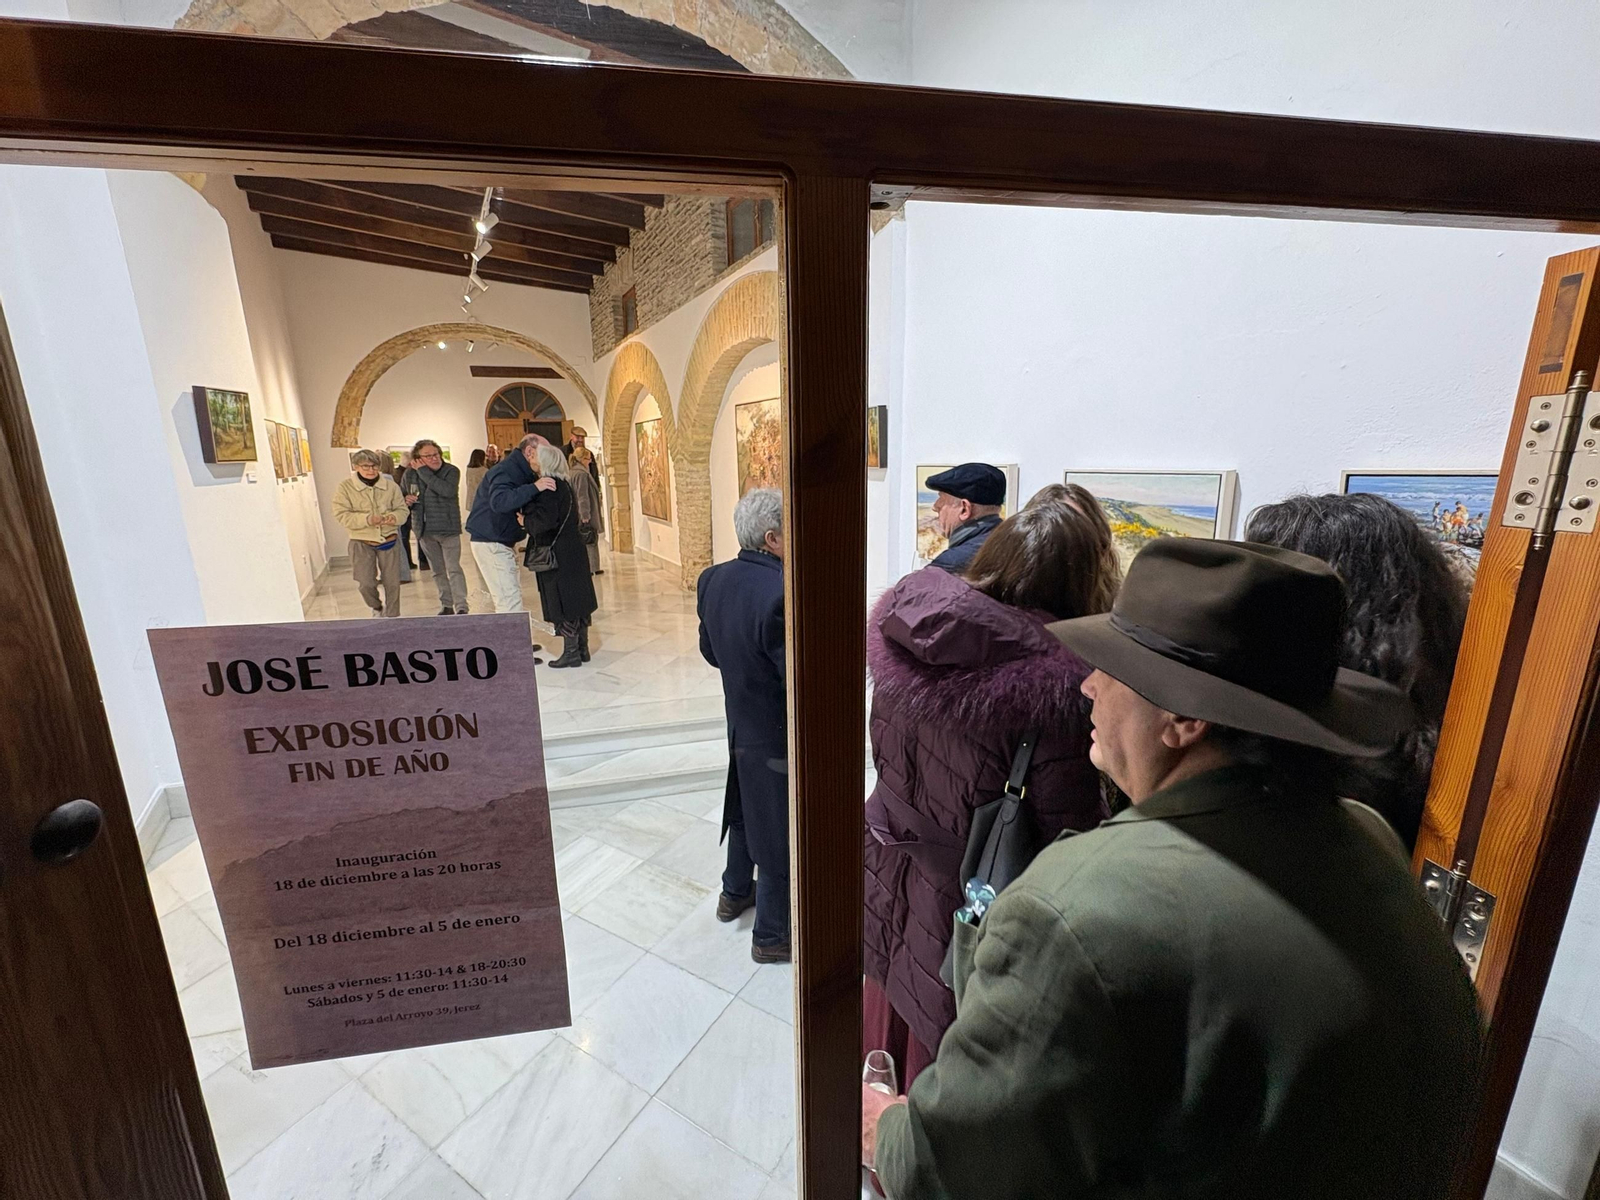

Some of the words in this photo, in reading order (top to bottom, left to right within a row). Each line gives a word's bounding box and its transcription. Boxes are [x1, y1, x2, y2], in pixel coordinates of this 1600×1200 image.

[202, 647, 329, 697] JOSÉ
[344, 646, 499, 687] BASTO
[243, 708, 480, 755] EXPOSICIÓN
[288, 759, 335, 783] FIN
[344, 757, 385, 778] DE
[394, 749, 450, 775] AÑO
[273, 879, 294, 892] 18
[297, 876, 316, 890] de
[320, 868, 398, 887] diciembre
[401, 869, 411, 879] a
[413, 865, 435, 878] las
[437, 863, 457, 876] 20
[459, 859, 501, 873] horas
[335, 848, 437, 868] Inauguración
[273, 935, 302, 949] Del
[305, 933, 328, 946] 18
[331, 925, 415, 944] diciembre
[418, 921, 435, 935] al
[437, 920, 447, 932] 5
[451, 917, 471, 930] de
[474, 913, 521, 928] enero
[283, 982, 325, 996] Lunes
[327, 981, 336, 991] a
[338, 974, 392, 990] viernes:
[395, 965, 453, 983] 11:30-14
[456, 964, 467, 975] &
[469, 956, 527, 973] 18-20:30
[307, 993, 363, 1009] Sábados
[365, 992, 374, 1003] y
[376, 989, 385, 999] 5
[388, 986, 405, 998] de
[407, 981, 450, 996] enero:
[452, 974, 509, 990] 11:30-14
[344, 1017, 375, 1029] Plaza
[376, 1013, 394, 1025] del
[396, 1008, 434, 1022] Arroyo
[435, 1006, 453, 1017] 39,
[453, 1002, 481, 1014] Jerez
